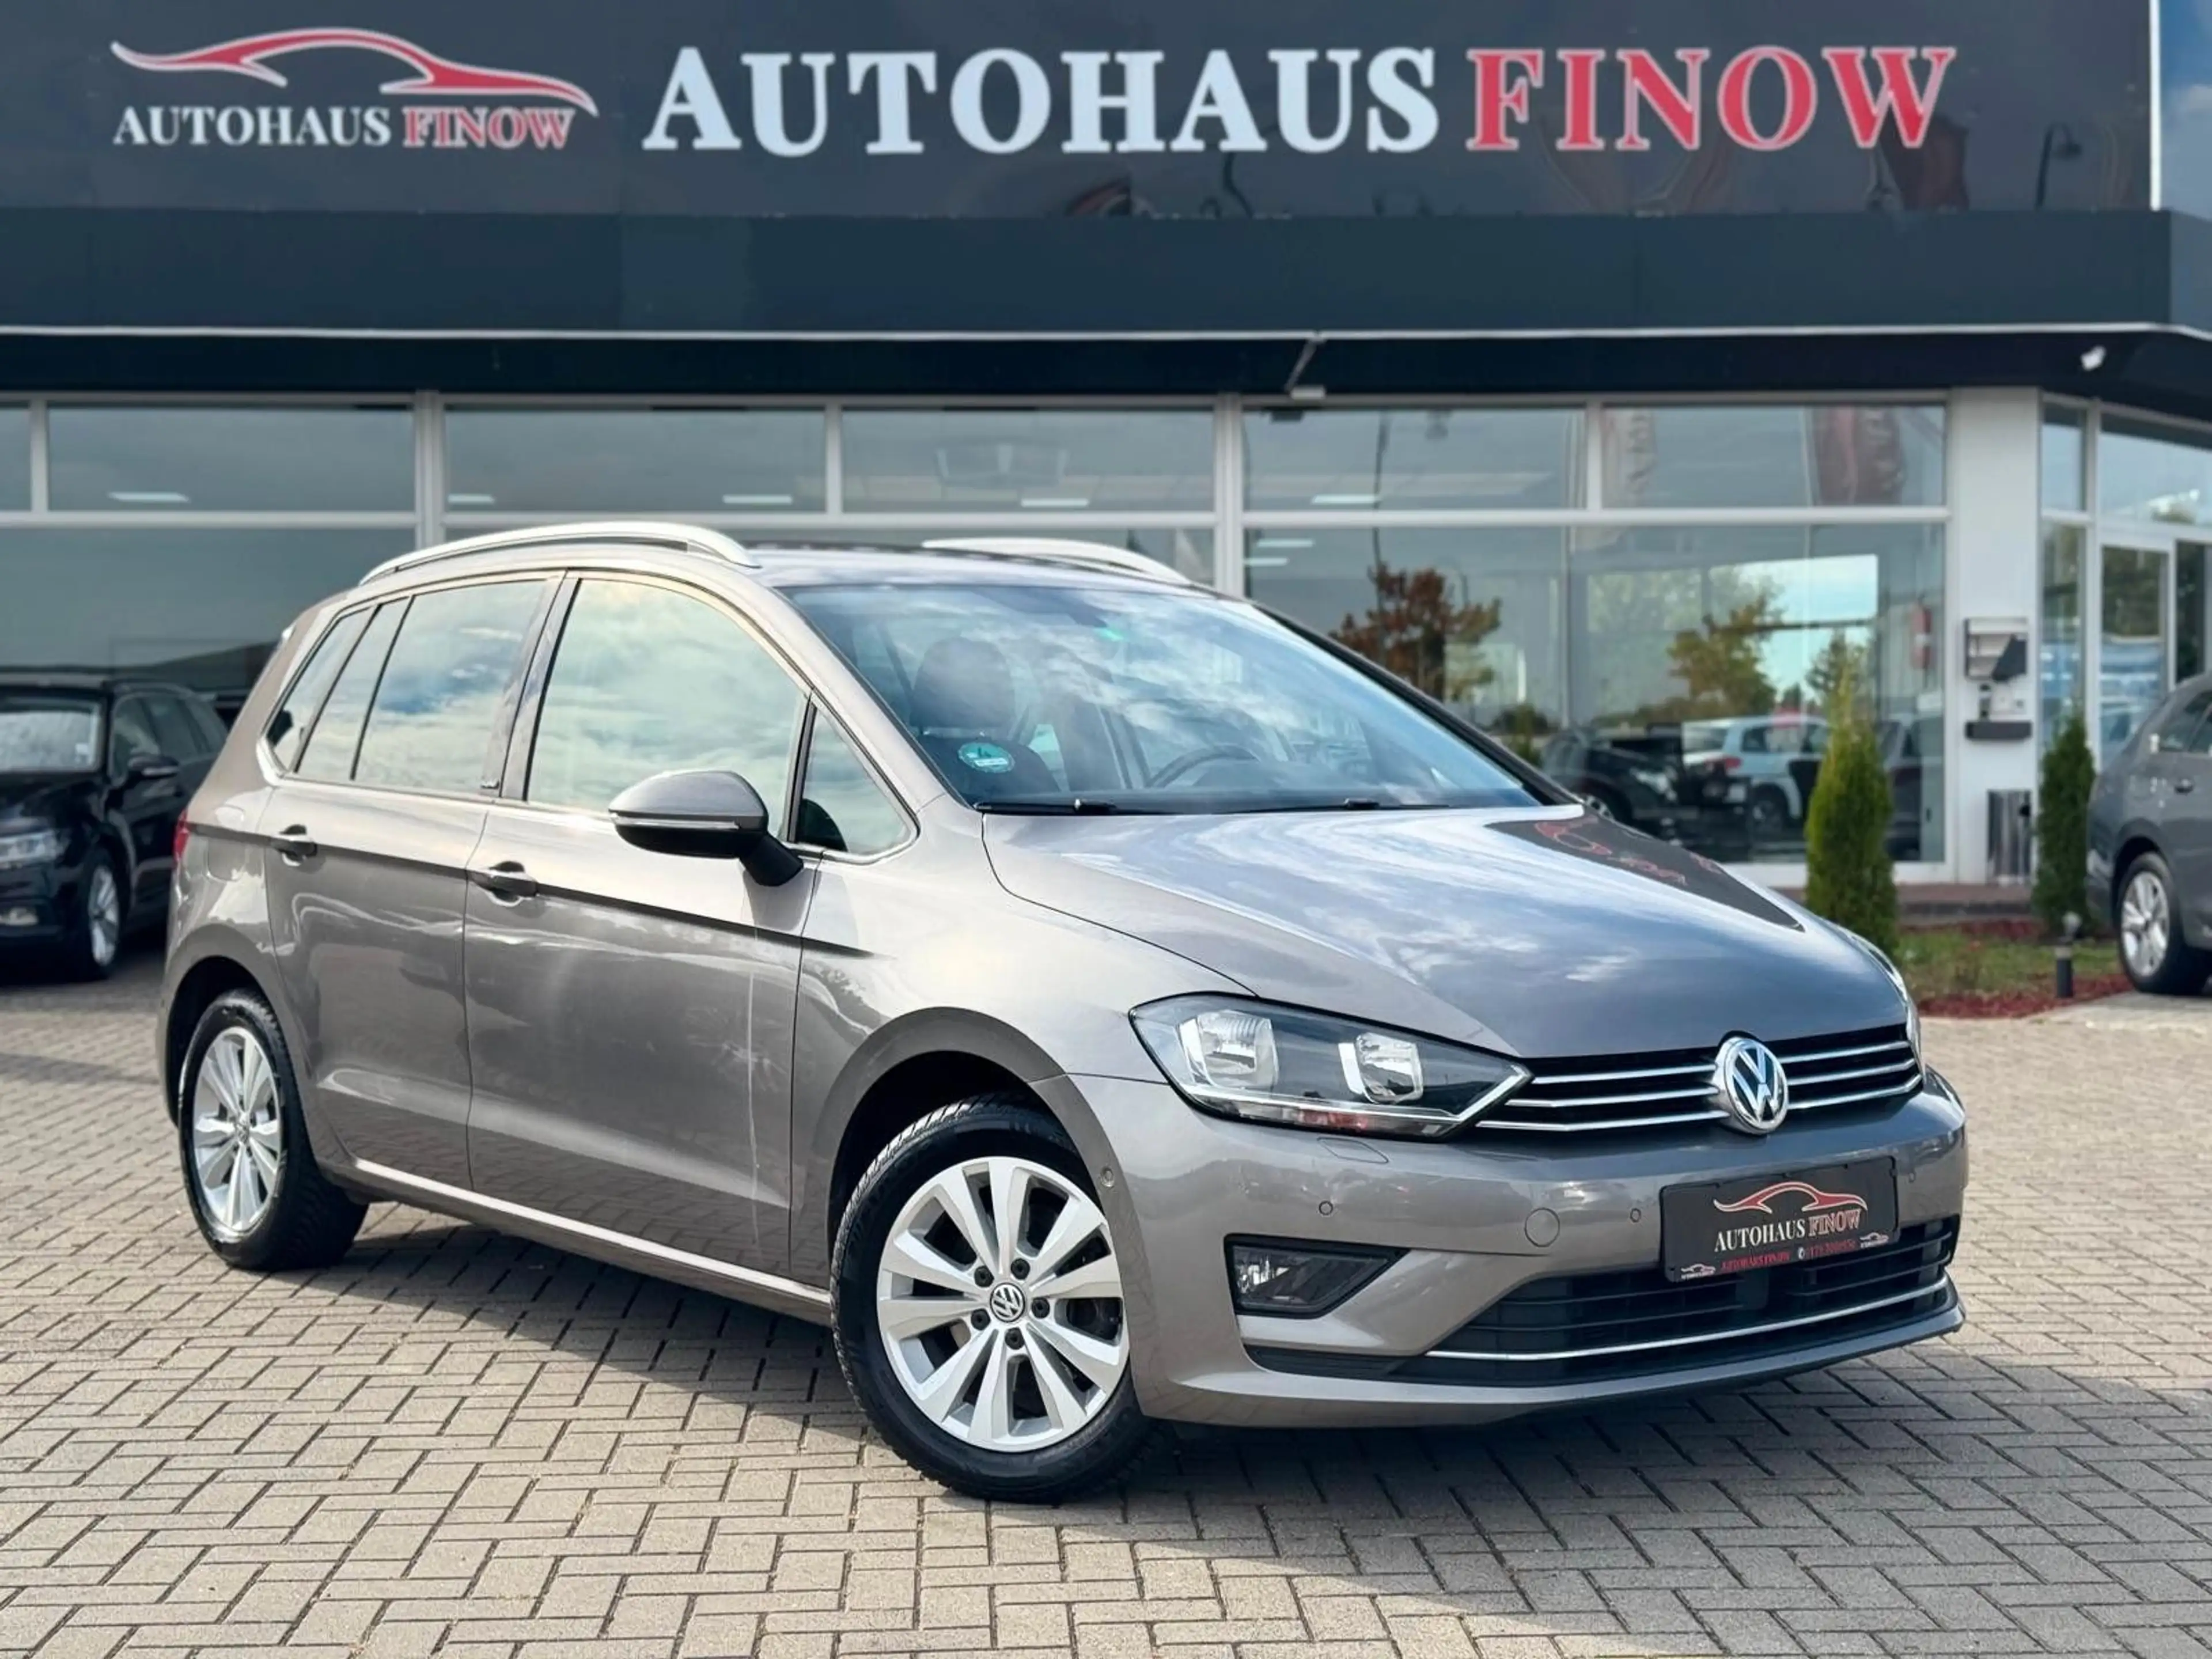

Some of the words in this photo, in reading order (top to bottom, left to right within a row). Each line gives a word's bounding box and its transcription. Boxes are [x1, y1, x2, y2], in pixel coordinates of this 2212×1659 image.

[642, 47, 1439, 156] AUTOHAUS
[1465, 46, 1957, 151] FINOW
[113, 106, 392, 146] AUTOHAUS
[402, 106, 575, 148] FINOW
[1714, 1219, 1805, 1252] AUTOHAUS
[1808, 1209, 1861, 1237] FINOW
